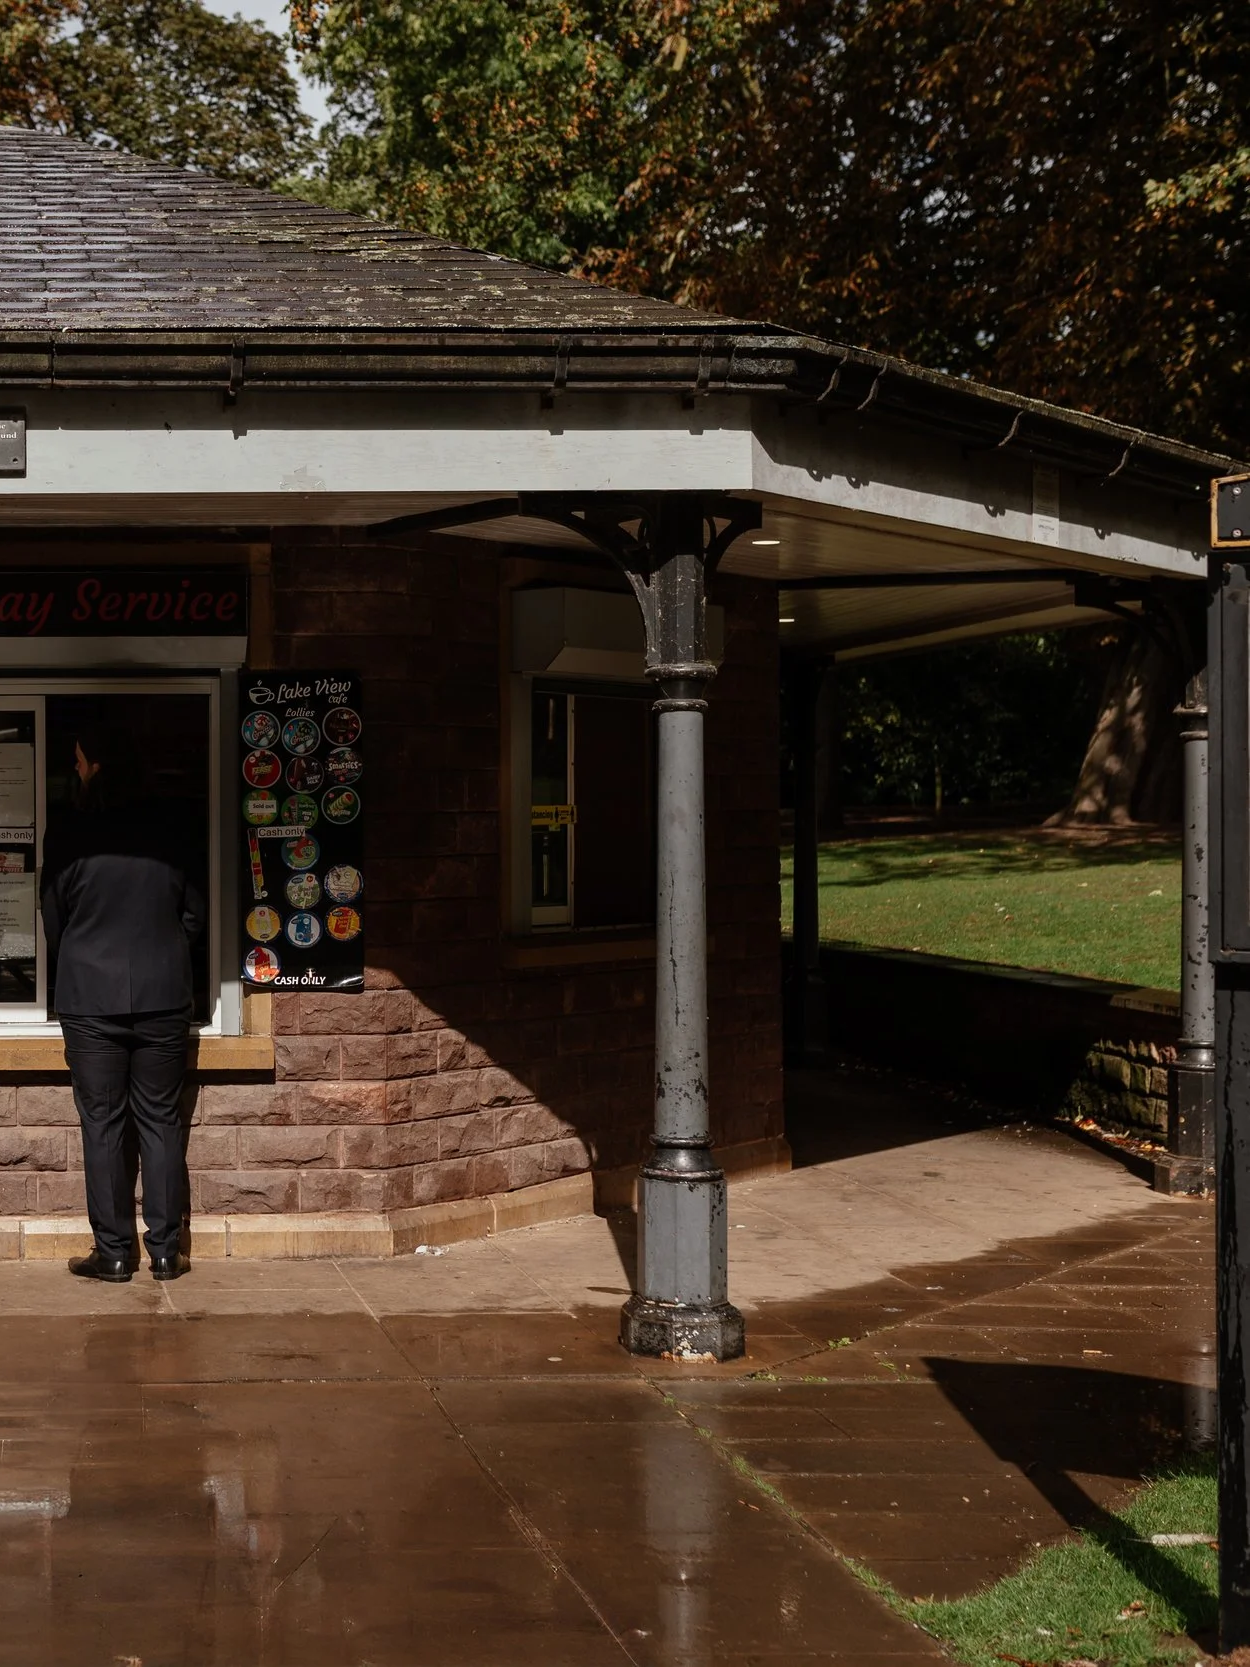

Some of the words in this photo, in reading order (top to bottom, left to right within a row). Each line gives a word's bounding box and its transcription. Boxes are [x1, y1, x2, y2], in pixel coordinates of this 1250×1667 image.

[71, 577, 238, 622] Service
[277, 681, 311, 704] Lake
[314, 677, 352, 696] View
[285, 707, 316, 719] Lollies
[14, 830, 33, 842] only
[258, 827, 284, 837] Cash
[286, 825, 305, 837] only
[274, 976, 300, 985] CASH
[301, 975, 327, 985] ONLY
